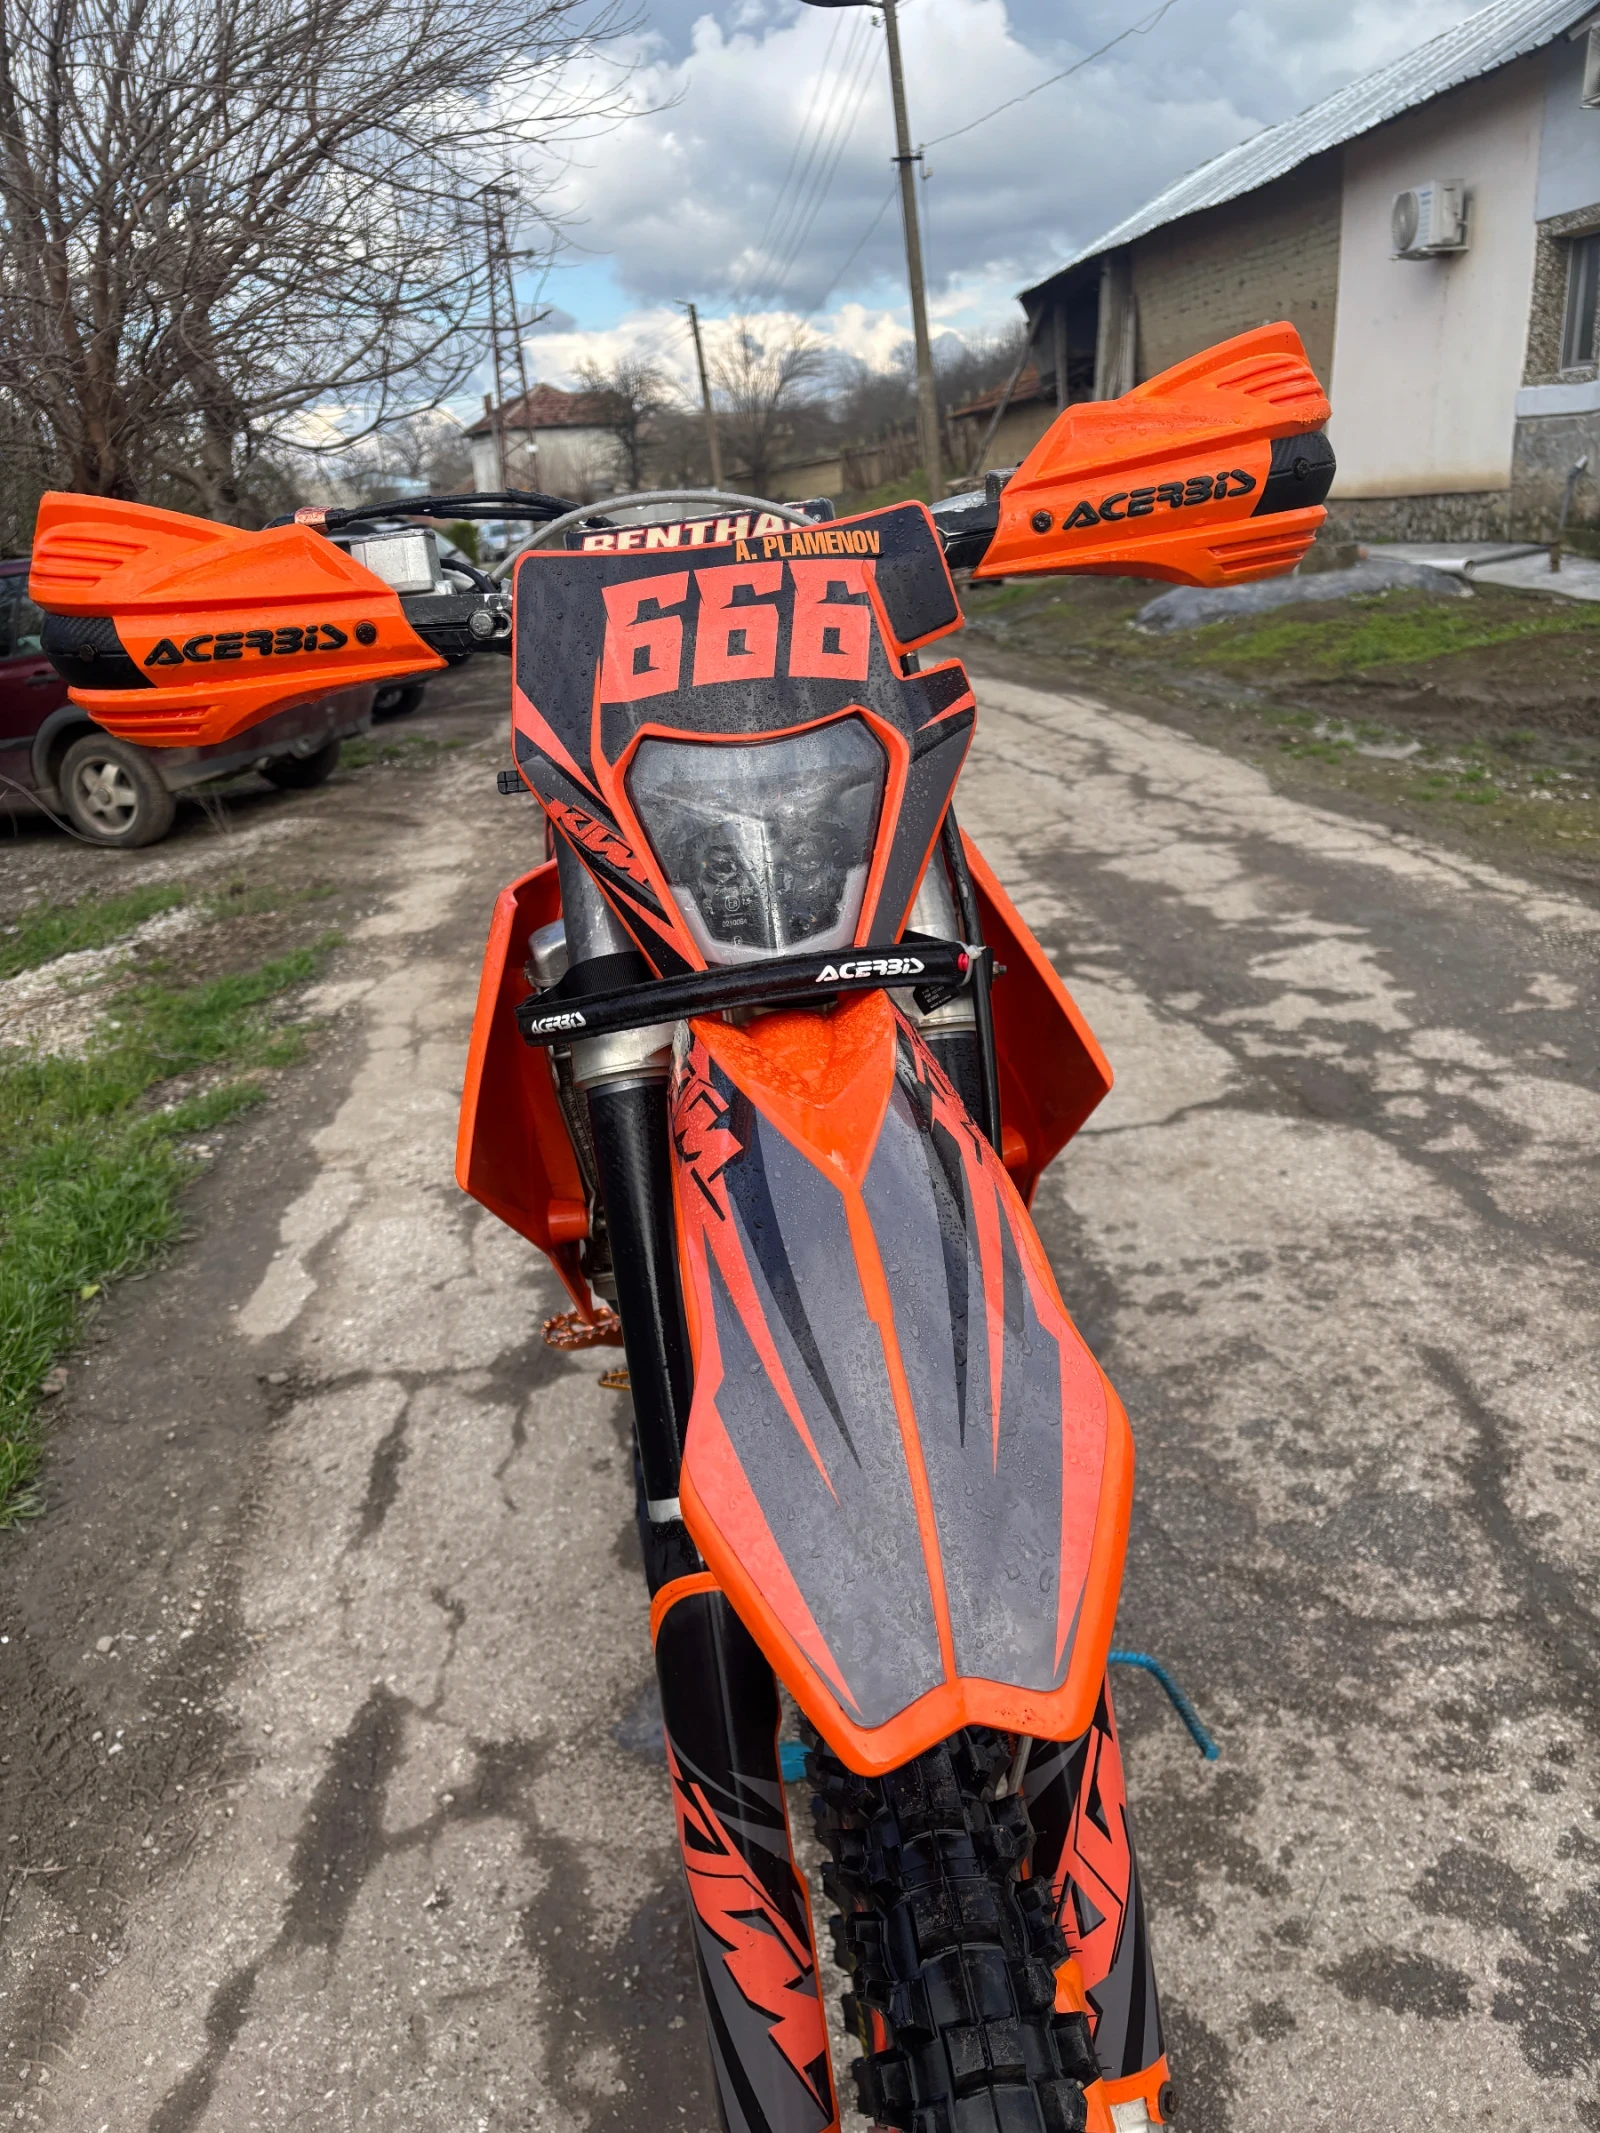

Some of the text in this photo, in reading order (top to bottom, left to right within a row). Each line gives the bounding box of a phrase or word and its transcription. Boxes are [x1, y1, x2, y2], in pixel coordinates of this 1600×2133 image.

[736, 530, 880, 563] A. PLAMENOV
[600, 559, 877, 704] 666
